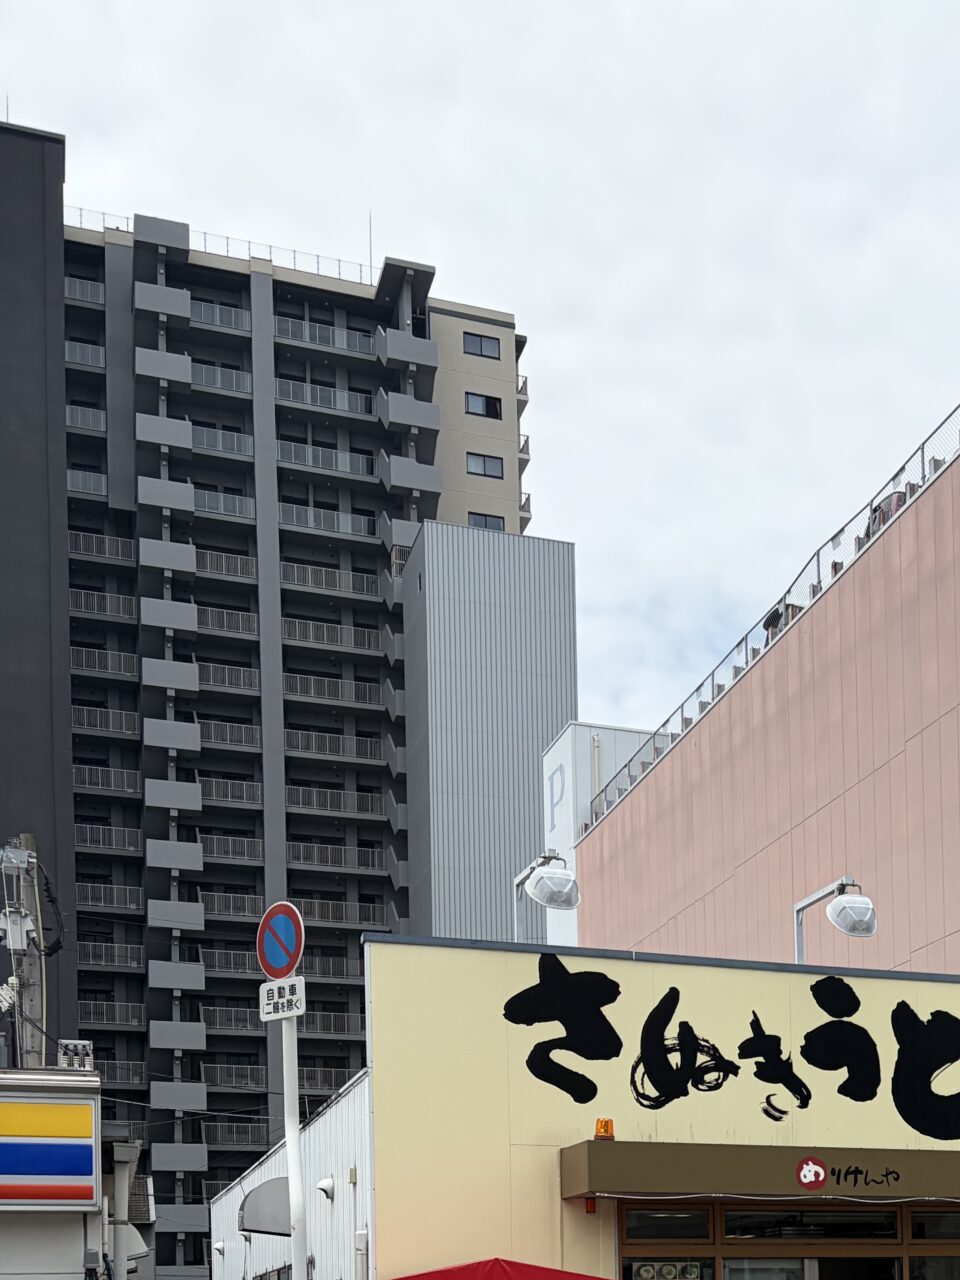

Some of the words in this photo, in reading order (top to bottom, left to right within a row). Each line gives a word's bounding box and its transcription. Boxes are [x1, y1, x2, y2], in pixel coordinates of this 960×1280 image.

[548, 762, 566, 833] P
[266, 983, 297, 1002] 自動車
[799, 1160, 901, 1188] めりけんや
